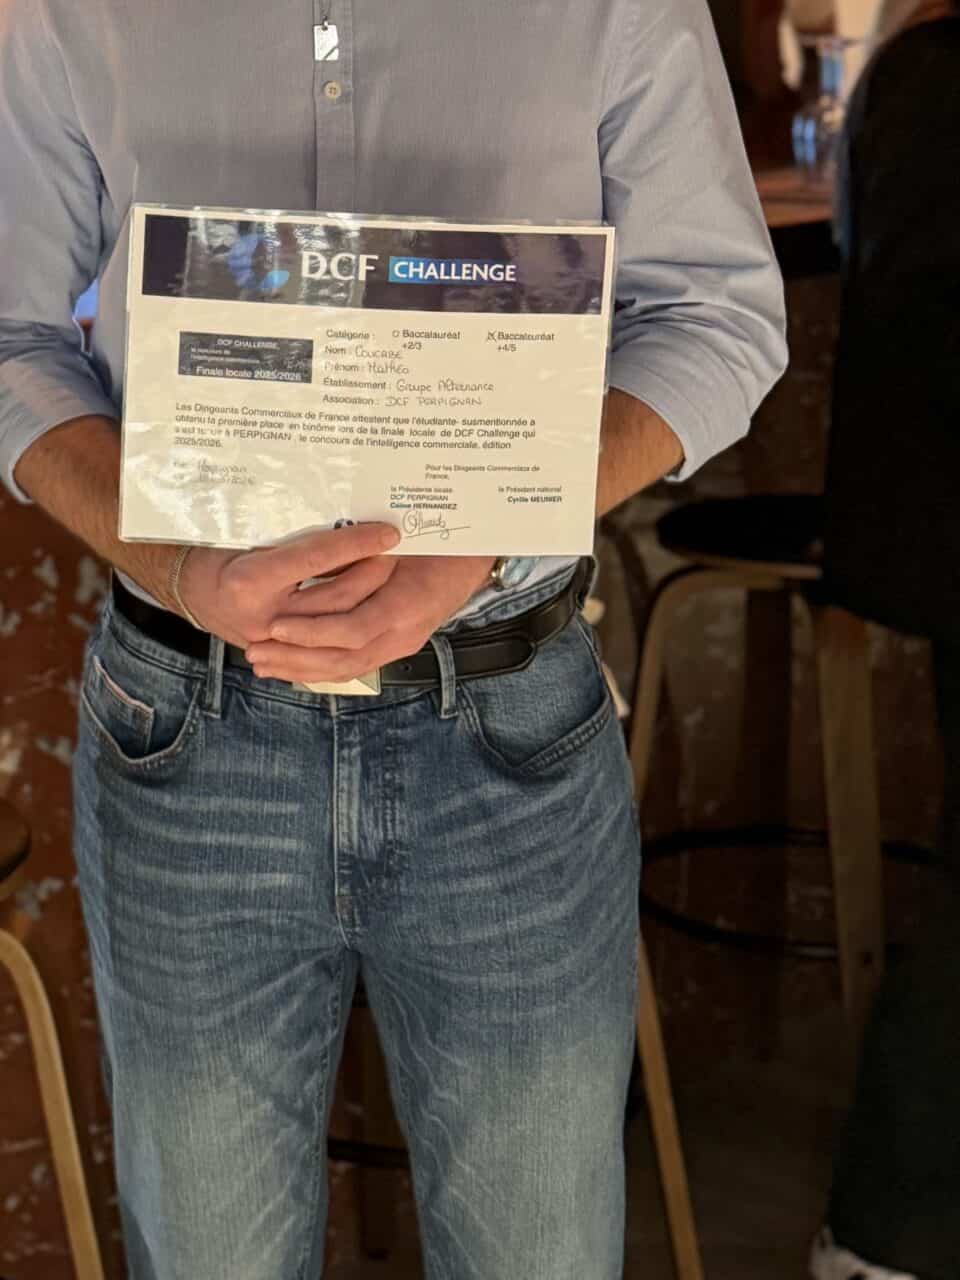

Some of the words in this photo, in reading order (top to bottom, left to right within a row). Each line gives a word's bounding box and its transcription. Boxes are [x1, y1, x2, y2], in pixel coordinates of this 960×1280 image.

[301, 251, 378, 281] DCF
[394, 261, 516, 281] CHALLENGE
[196, 366, 223, 376] Finale
[226, 369, 252, 378] locale
[304, 411, 316, 420] de
[319, 412, 350, 422] France
[392, 417, 409, 425] que
[233, 429, 291, 441] PERPIGNAN
[310, 435, 350, 445] concours
[352, 436, 364, 446] de
[357, 426, 368, 434] de
[381, 427, 404, 436] finale
[410, 428, 436, 436] locale
[440, 429, 452, 437] de
[455, 429, 474, 437] DCF
[476, 429, 520, 439] Challenge
[522, 431, 536, 439] qui
